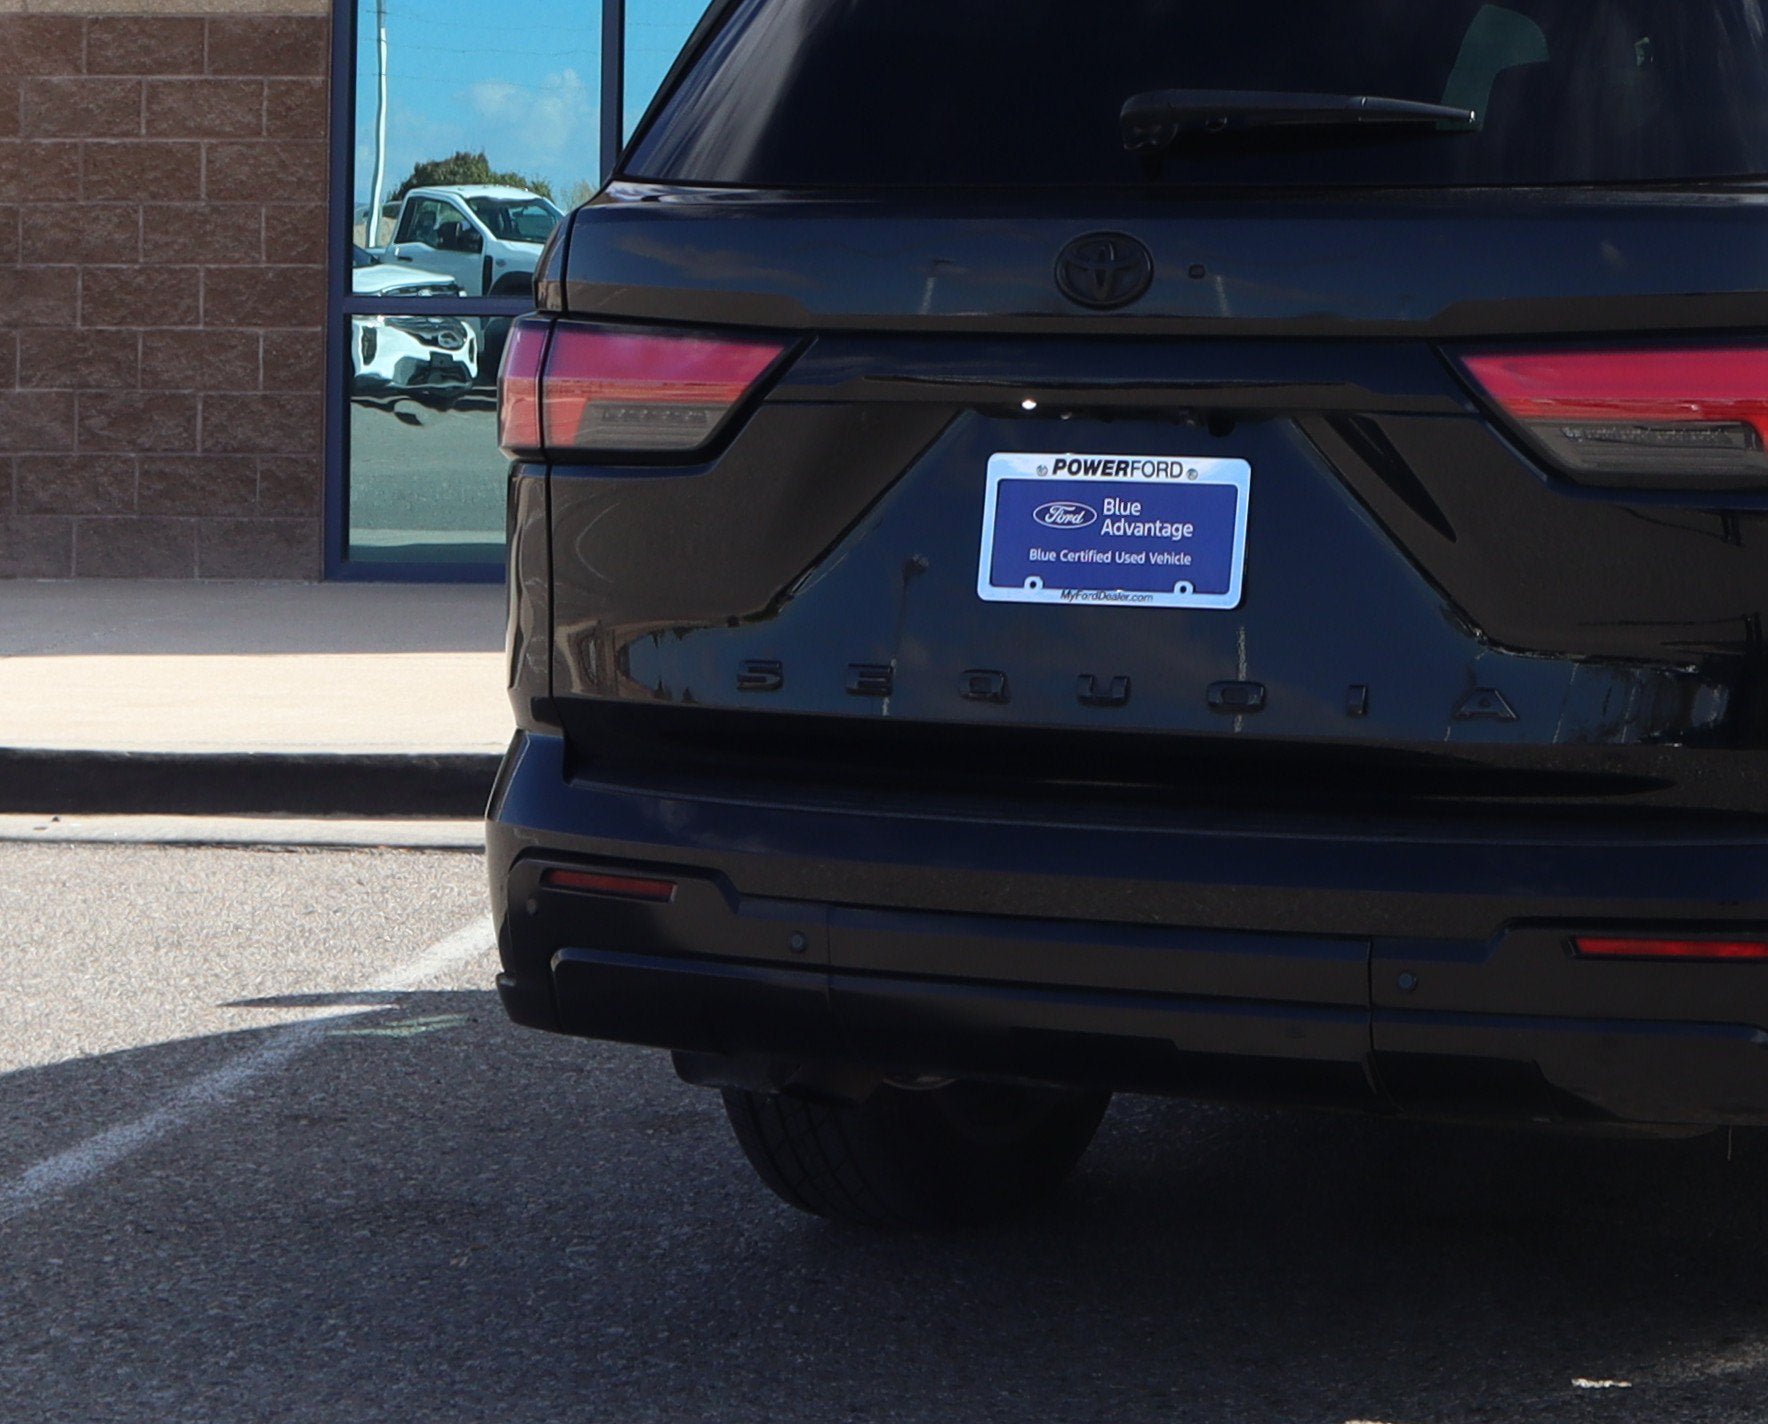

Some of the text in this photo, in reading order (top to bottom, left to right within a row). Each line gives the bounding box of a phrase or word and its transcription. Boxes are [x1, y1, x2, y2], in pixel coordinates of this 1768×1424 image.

[1044, 504, 1086, 525] Ford
[1103, 497, 1142, 517] Blue
[1101, 518, 1194, 540] Advantage
[1028, 548, 1193, 566] Blue Certified Used Vehicle
[1060, 588, 1154, 603] MyFordDealer.com
[734, 658, 1520, 723] SEQUOIA
